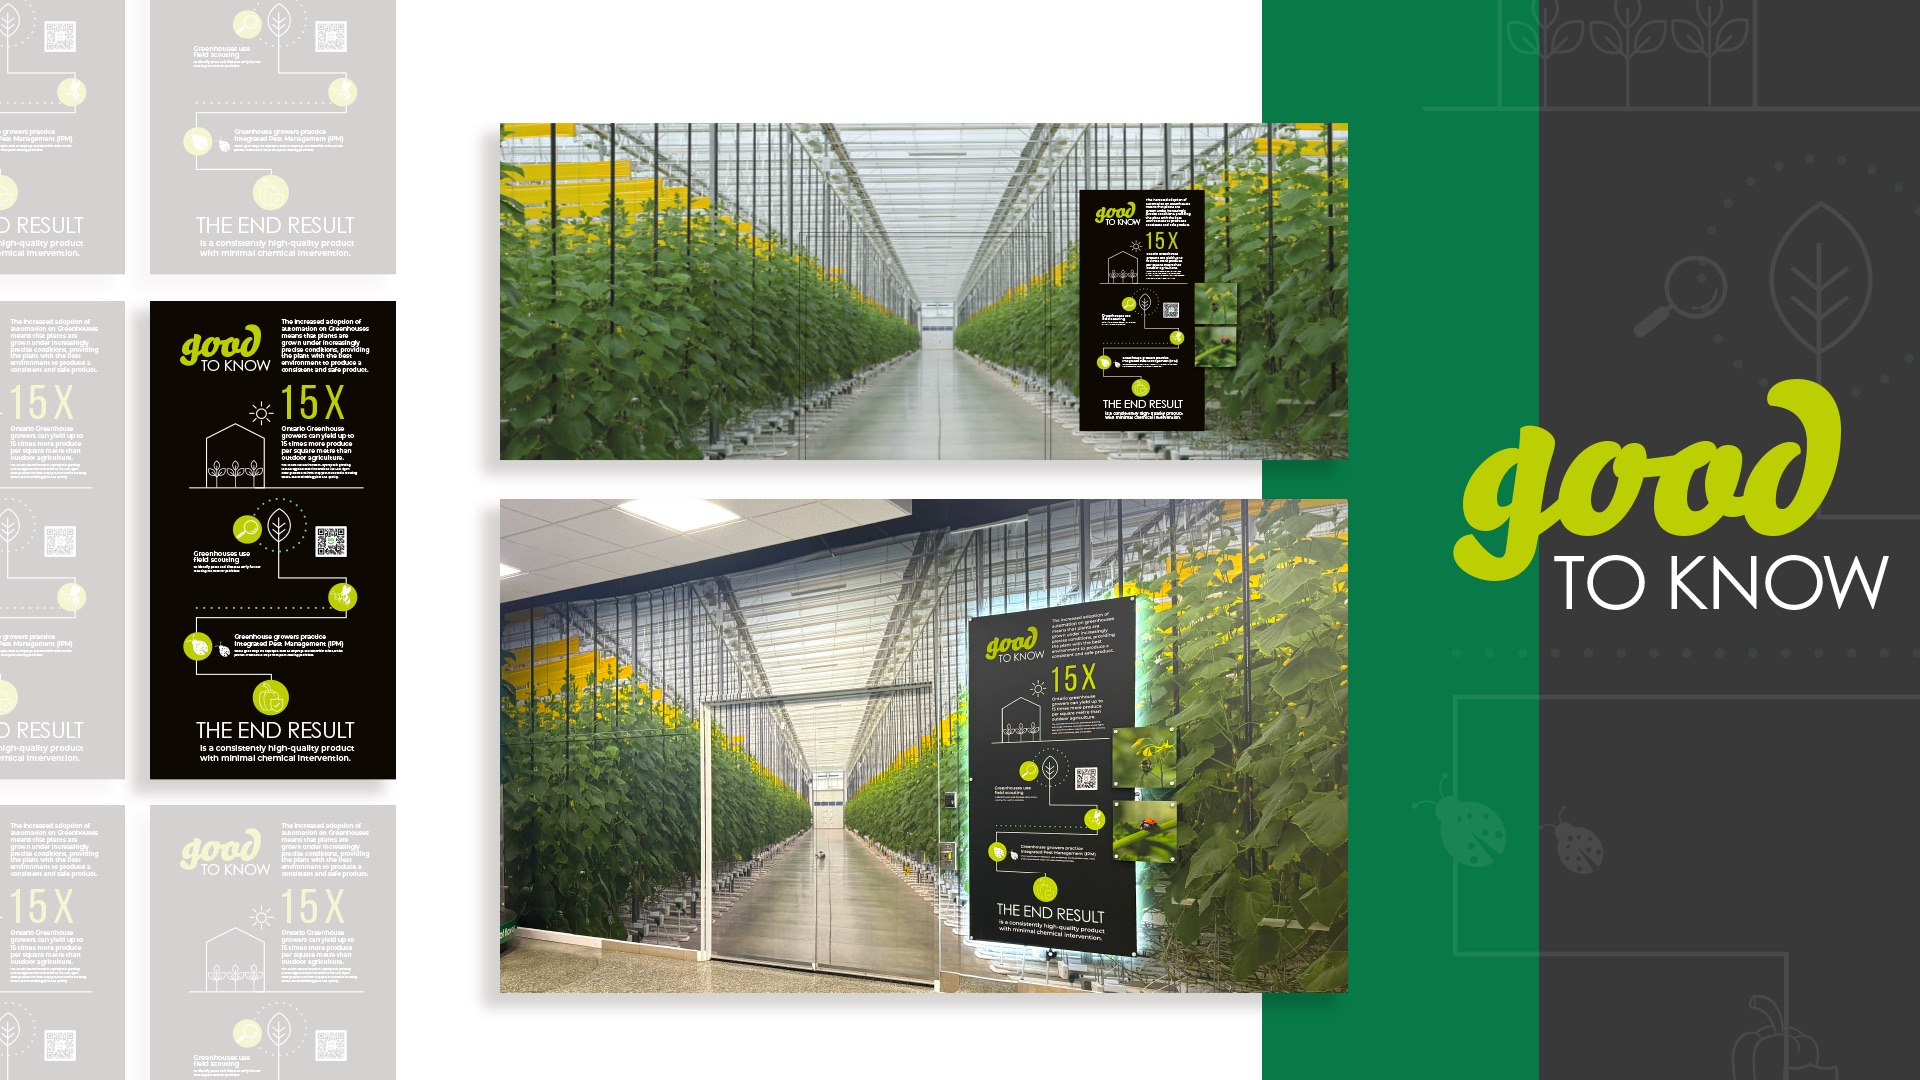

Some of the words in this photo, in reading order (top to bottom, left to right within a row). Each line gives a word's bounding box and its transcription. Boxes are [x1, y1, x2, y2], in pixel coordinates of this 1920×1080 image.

[1095, 201, 1136, 223] good
[17, 217, 84, 233] RESULT
[196, 217, 232, 233] THE
[239, 217, 281, 233] END
[289, 217, 355, 233] RESULT
[1146, 232, 1178, 249] 15X
[180, 324, 261, 366] good
[201, 360, 220, 371] TO
[225, 360, 271, 371] KNOW
[10, 385, 73, 419] 15X
[281, 385, 344, 419] 15X
[1103, 400, 1121, 408] THE
[1124, 400, 1146, 408] END
[1150, 400, 1183, 408] RESULT
[1453, 378, 1842, 582] good
[1554, 554, 1646, 611] TO
[1670, 554, 1889, 611] KNOW
[985, 626, 1038, 660] good
[999, 653, 1012, 663] TO
[1014, 650, 1045, 662] KNOW
[1052, 662, 1096, 693] 15X
[17, 722, 84, 738] RESULT
[196, 722, 232, 738] THE
[239, 722, 281, 738] END
[289, 722, 355, 738] RESULT
[216, 745, 266, 753] consistently
[268, 745, 319, 753] high-quality
[321, 745, 354, 753] product
[180, 828, 261, 870] good
[201, 864, 220, 875] TO
[225, 864, 271, 875] KNOW
[10, 889, 73, 923] 15X
[281, 889, 344, 923] 15X
[997, 903, 1020, 916] THE
[1024, 905, 1053, 919] END
[1057, 908, 1105, 923] RESULT
[1043, 923, 1079, 932] high-quality
[1064, 933, 1102, 941] intervention.
